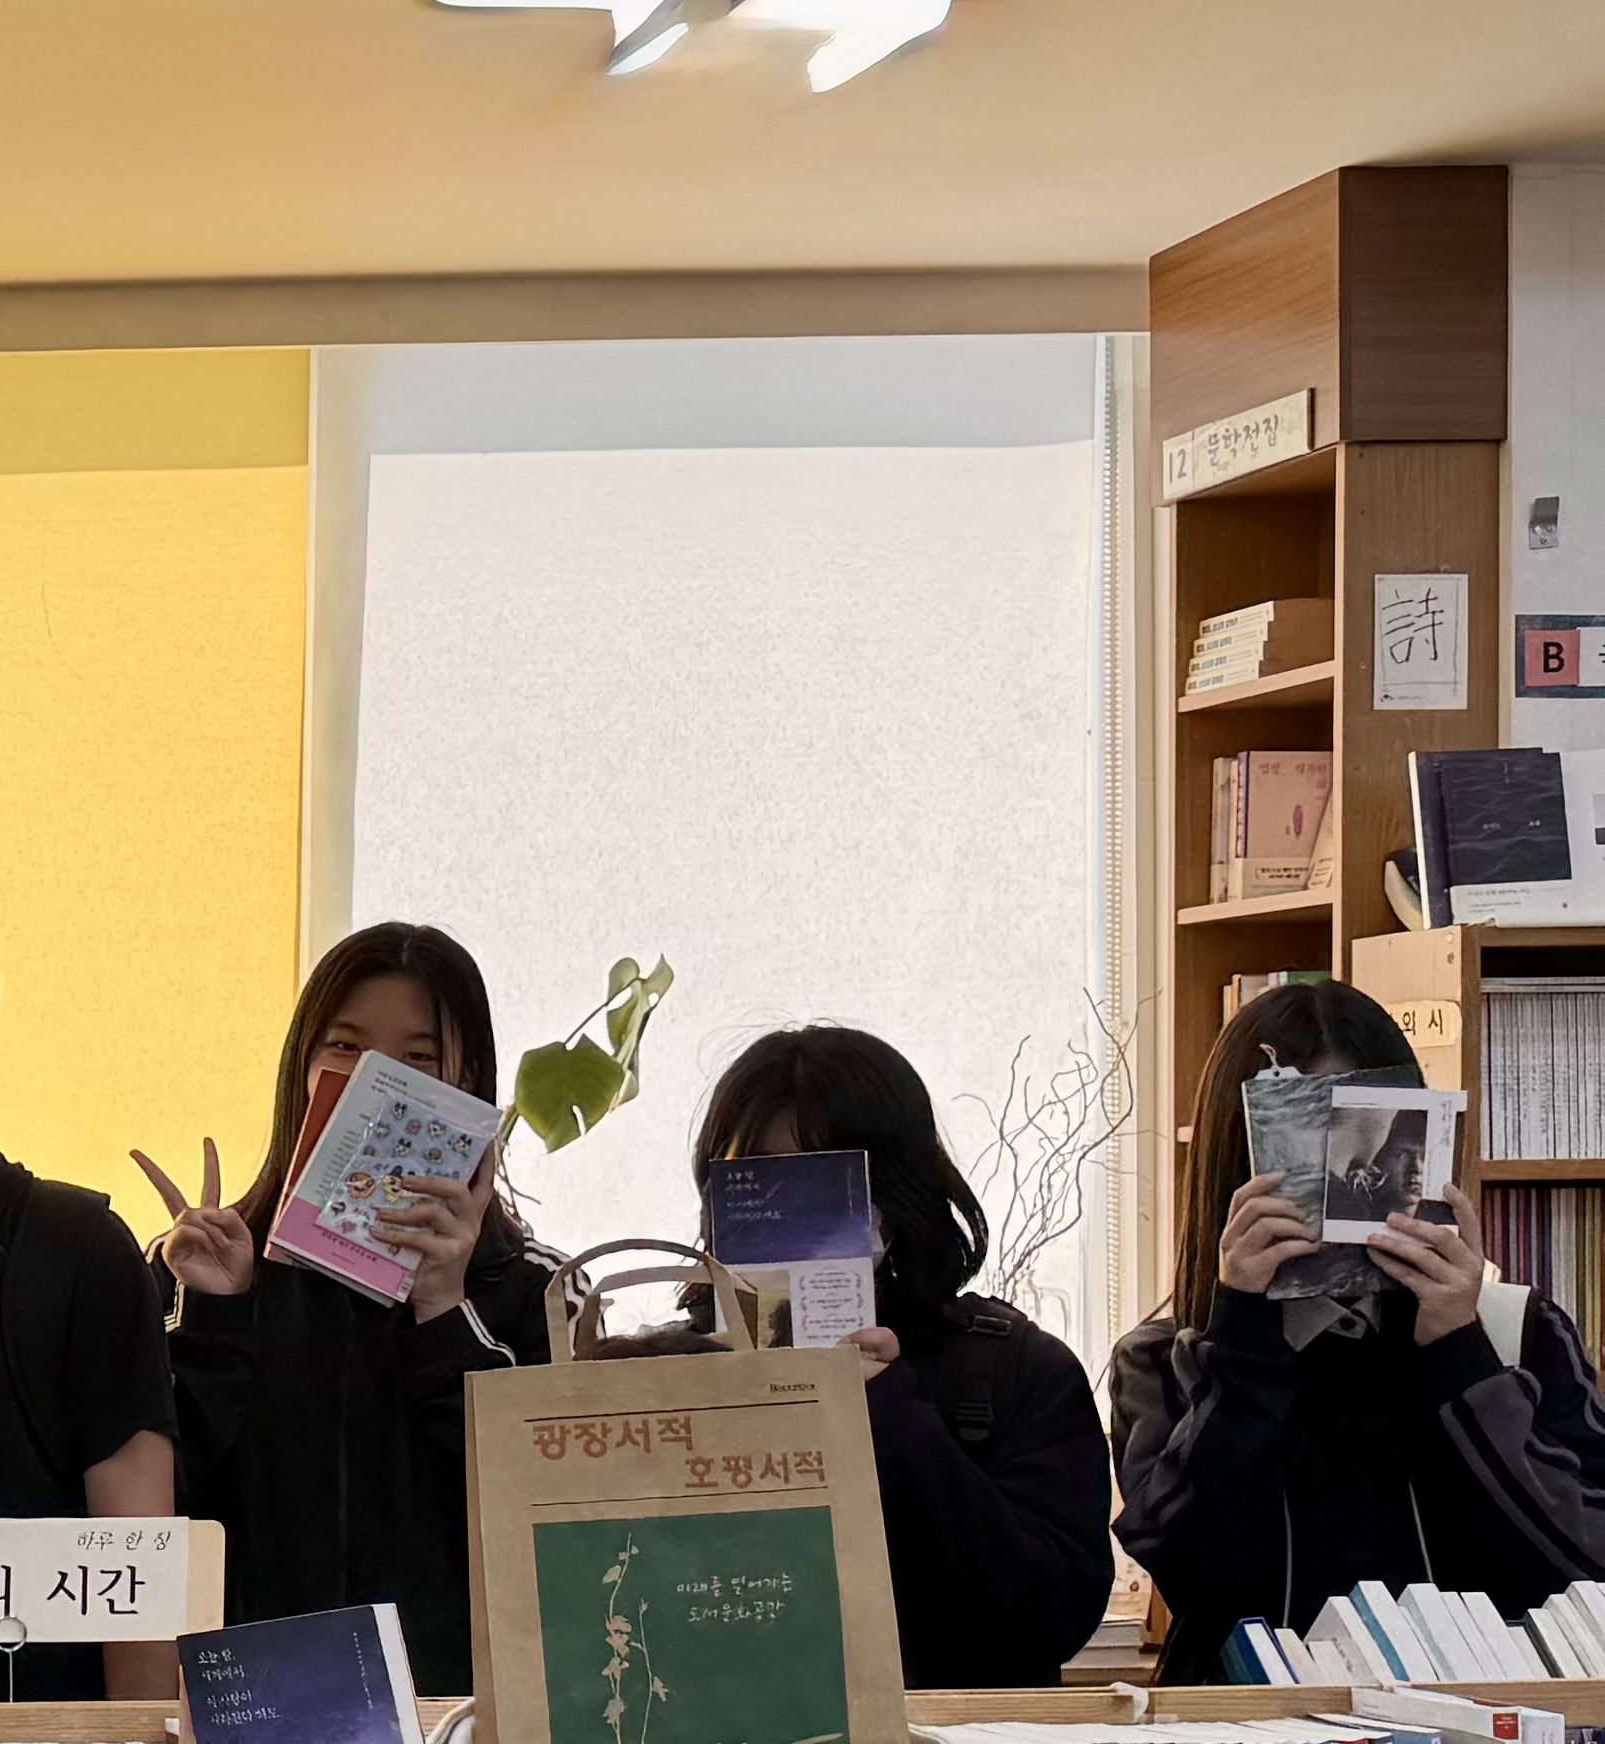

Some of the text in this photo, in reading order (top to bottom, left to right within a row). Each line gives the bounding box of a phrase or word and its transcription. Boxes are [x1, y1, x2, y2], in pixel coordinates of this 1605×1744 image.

[1169, 413, 1279, 484] 12 문학전집
[1381, 587, 1444, 665] 詩
[1542, 641, 1565, 673] B
[532, 1415, 695, 1462] 광장서적
[684, 1449, 827, 1490] 호평서적
[45, 1565, 147, 1617] 시간
